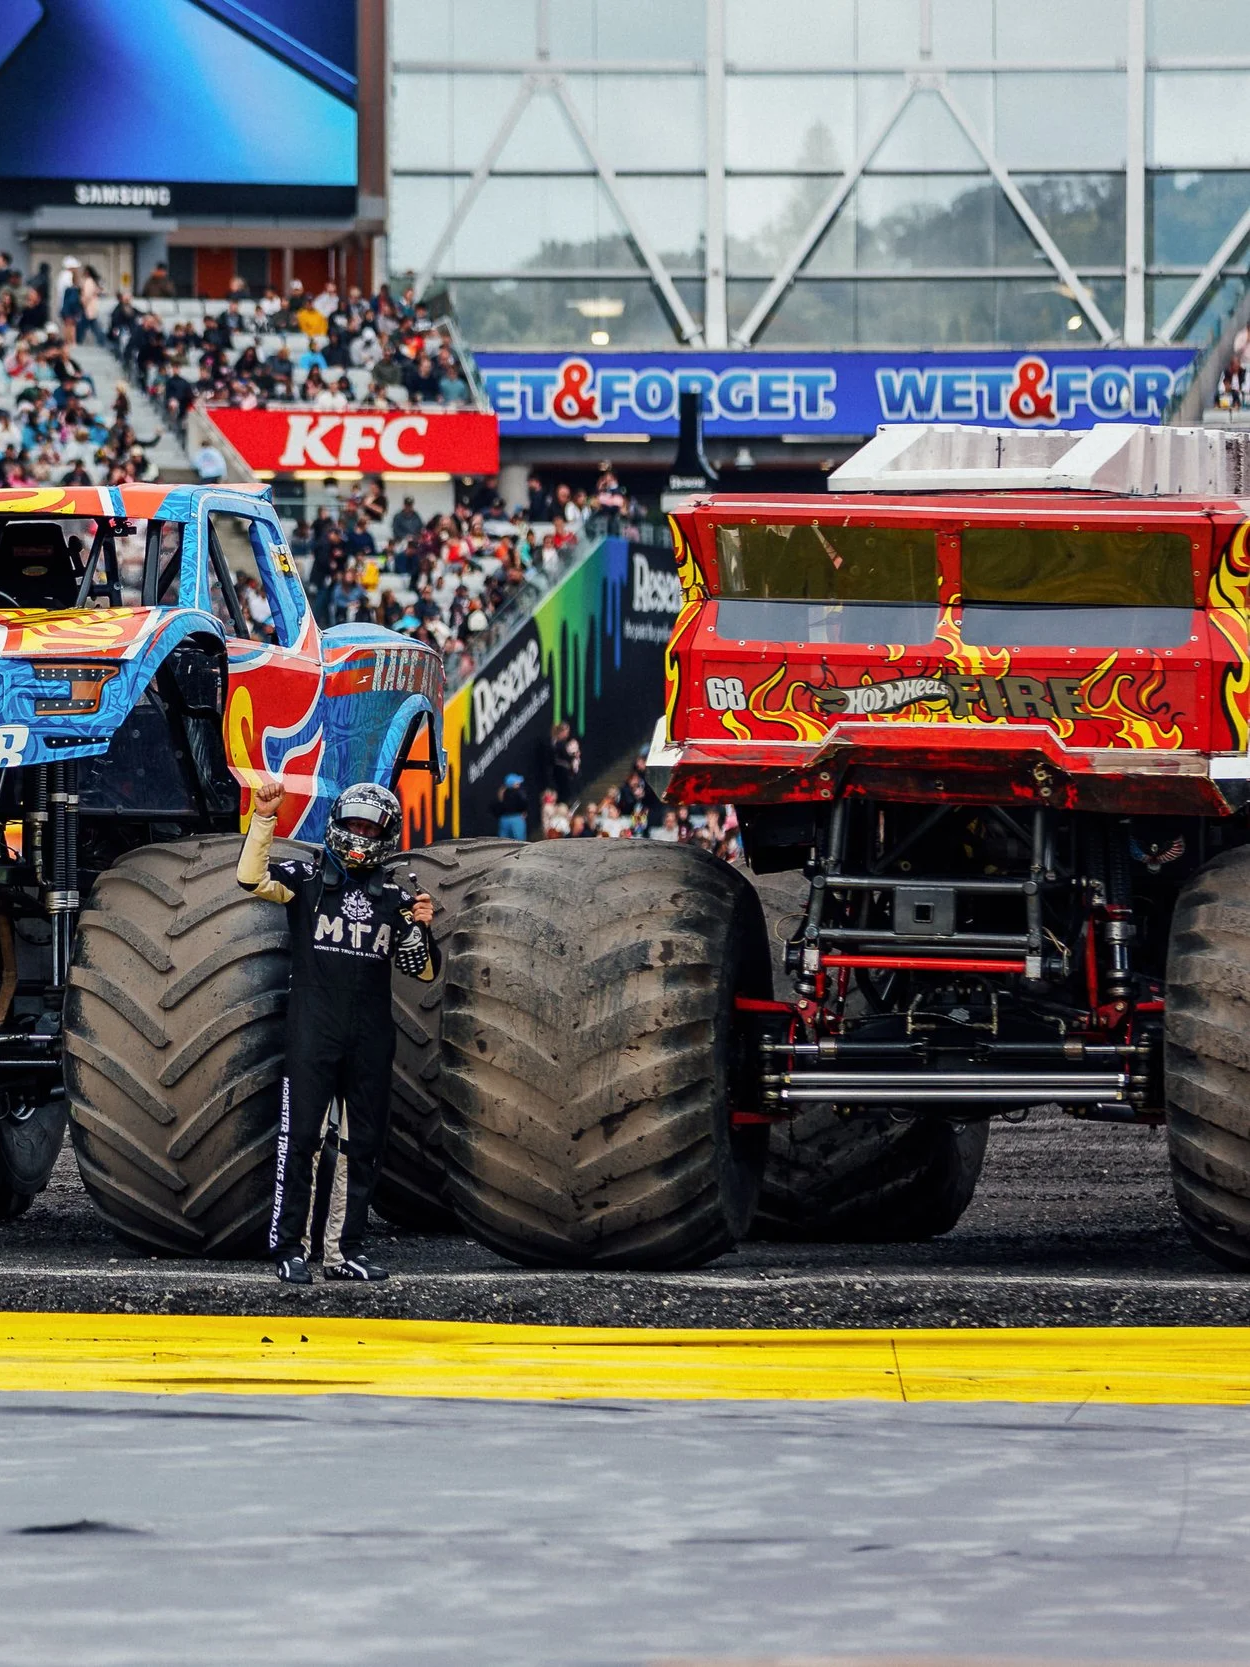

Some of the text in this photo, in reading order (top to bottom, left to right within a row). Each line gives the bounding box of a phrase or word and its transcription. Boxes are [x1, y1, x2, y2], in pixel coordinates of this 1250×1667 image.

[75, 184, 170, 206] SAMSUNG
[875, 356, 1187, 427] WET&FOR
[279, 415, 429, 468] KFC
[705, 677, 747, 711] 68
[950, 674, 1092, 721] FIRE
[314, 914, 392, 955] MTA
[269, 1076, 290, 1249] MONSTER TRUCKS AUSTRALIA
